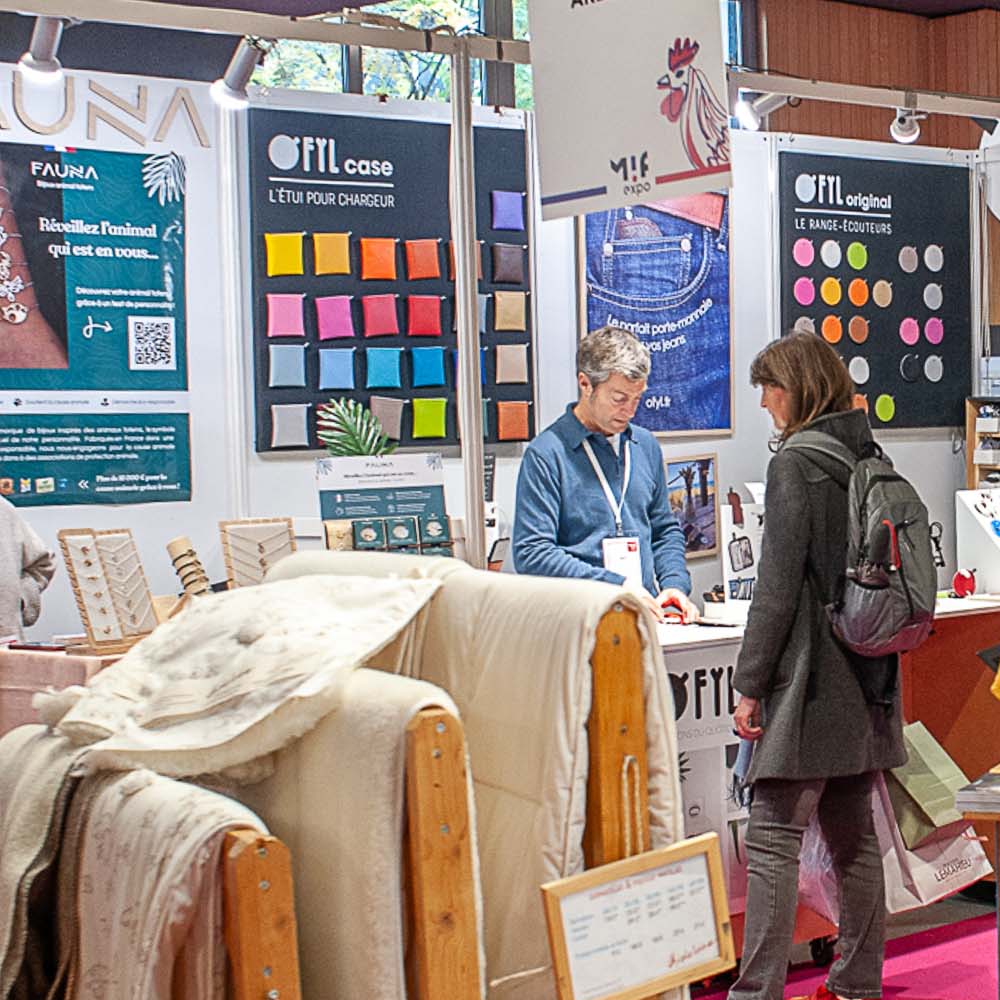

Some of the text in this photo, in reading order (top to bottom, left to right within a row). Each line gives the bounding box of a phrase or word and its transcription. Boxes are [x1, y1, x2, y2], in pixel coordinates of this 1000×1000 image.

[0, 70, 210, 148] UNA
[31, 160, 99, 180] FAUNA
[344, 157, 394, 176] case
[268, 187, 395, 208] L'ÉTUI POUR CHARGEUR
[623, 181, 652, 198] expo
[845, 192, 892, 211] original
[38, 216, 157, 238] Réveillez l'animal
[794, 217, 893, 235] LE RANGE-ÉCOUTEURS
[48, 241, 71, 258] qui
[72, 245, 94, 256] est
[95, 247, 113, 257] en
[607, 298, 713, 336] Le parfait porte-monnaie
[662, 334, 687, 353] jeans
